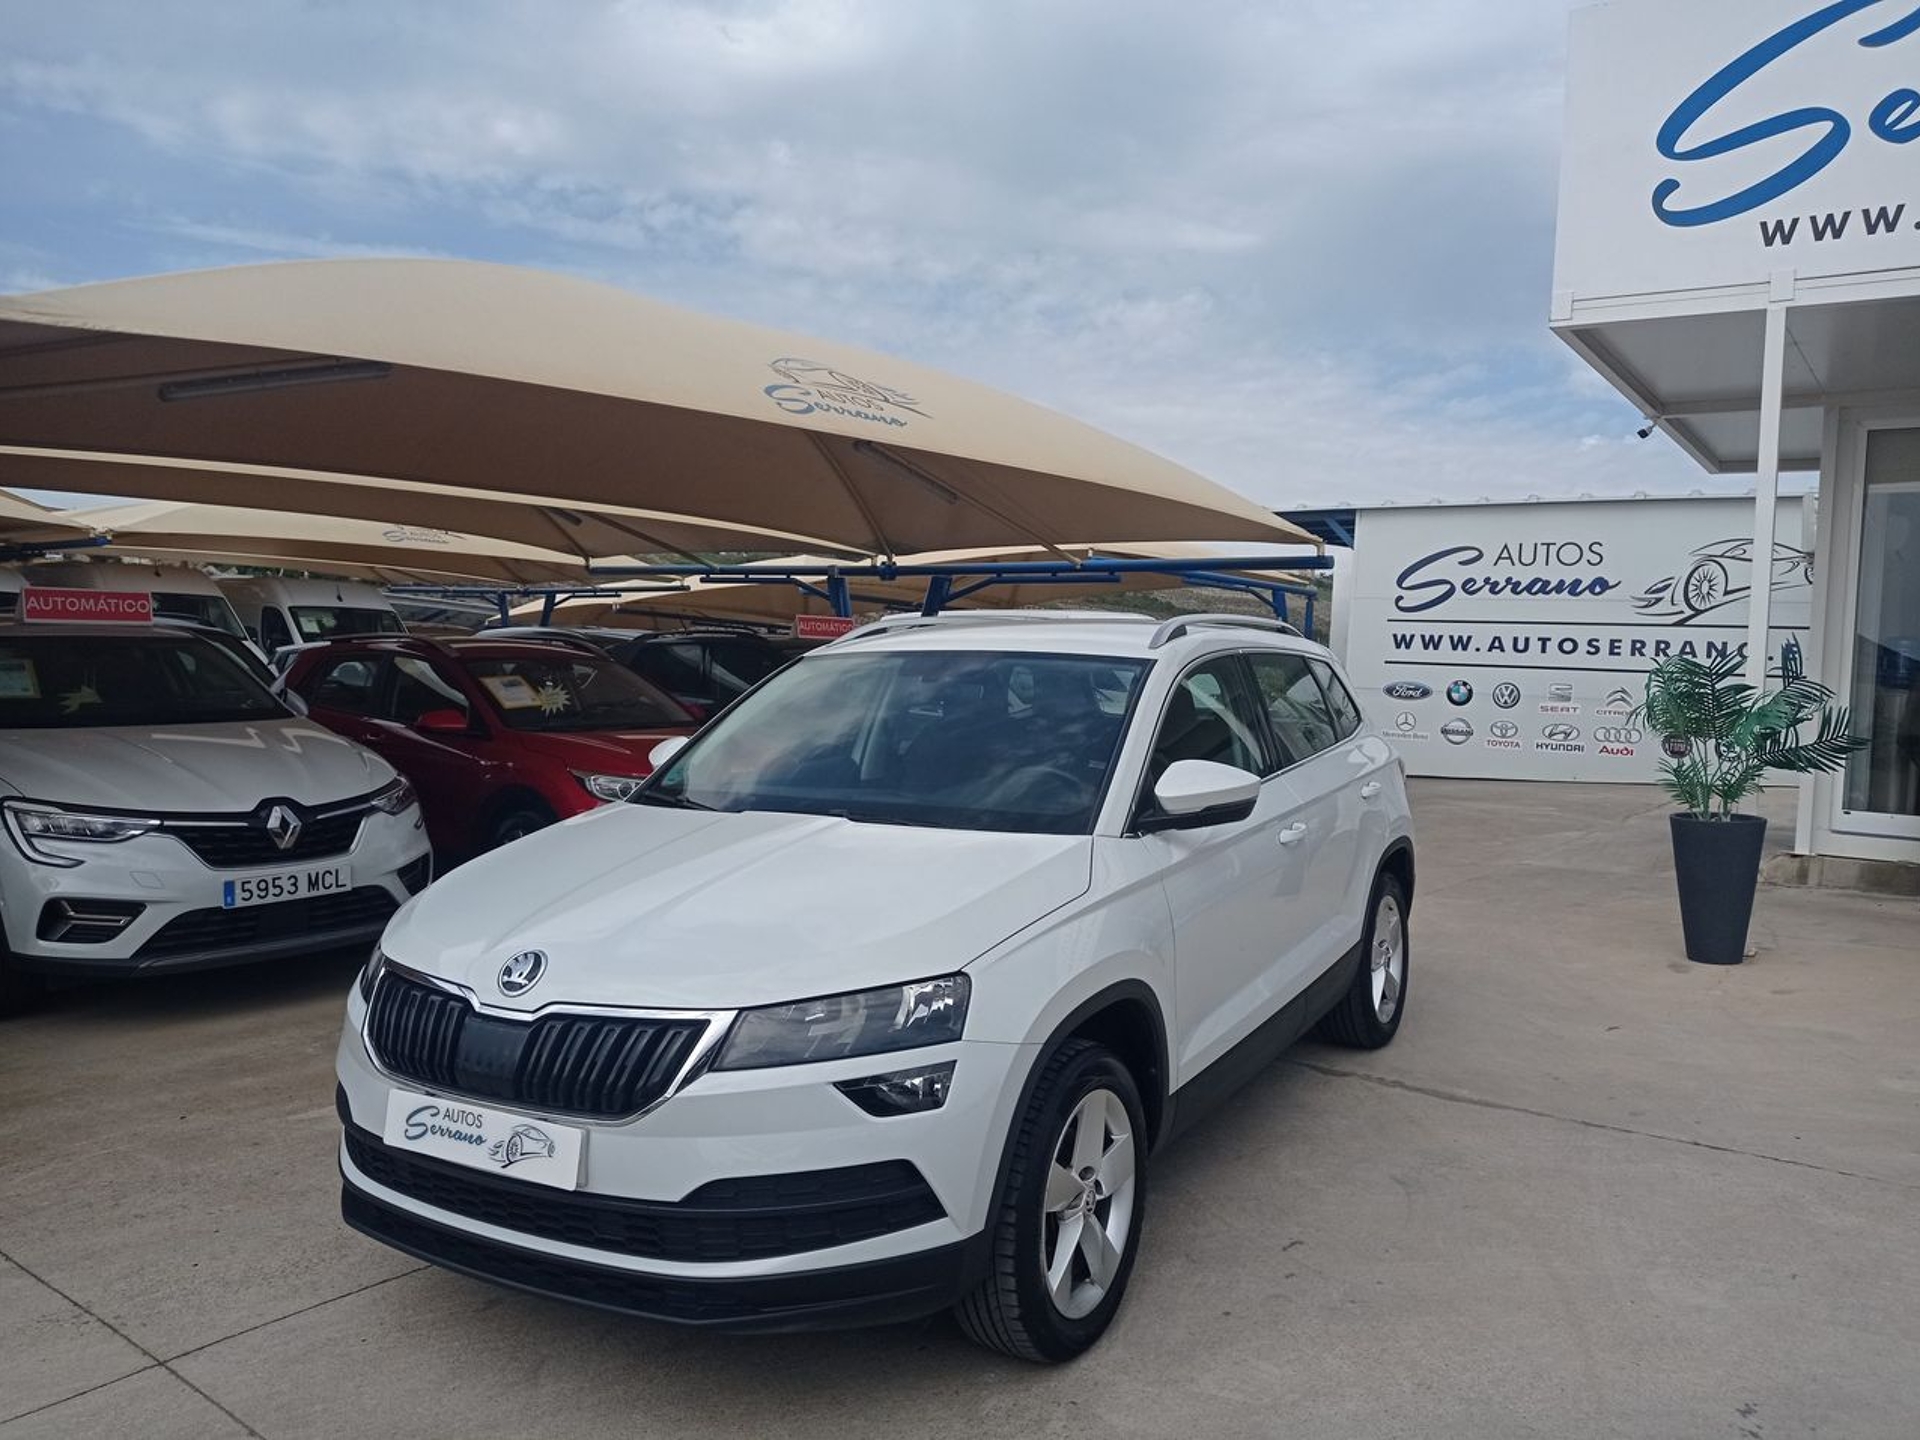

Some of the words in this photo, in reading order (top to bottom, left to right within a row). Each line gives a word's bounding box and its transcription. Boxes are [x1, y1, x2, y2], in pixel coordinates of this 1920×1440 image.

[1493, 541, 1604, 567] AUTOS
[1394, 545, 1623, 614] Serrano
[26, 595, 150, 613] AUTOMÁTICO
[1392, 684, 1423, 698] Ford
[1539, 705, 1579, 713] SEAT
[1486, 739, 1521, 749] TOYOTA
[1535, 741, 1585, 753] HYUNDAI
[1599, 745, 1634, 757] Audi
[241, 874, 299, 902] 5953
[307, 868, 347, 893] MCL
[404, 1104, 488, 1146] Serrano
[442, 1107, 483, 1129] AUTOS
